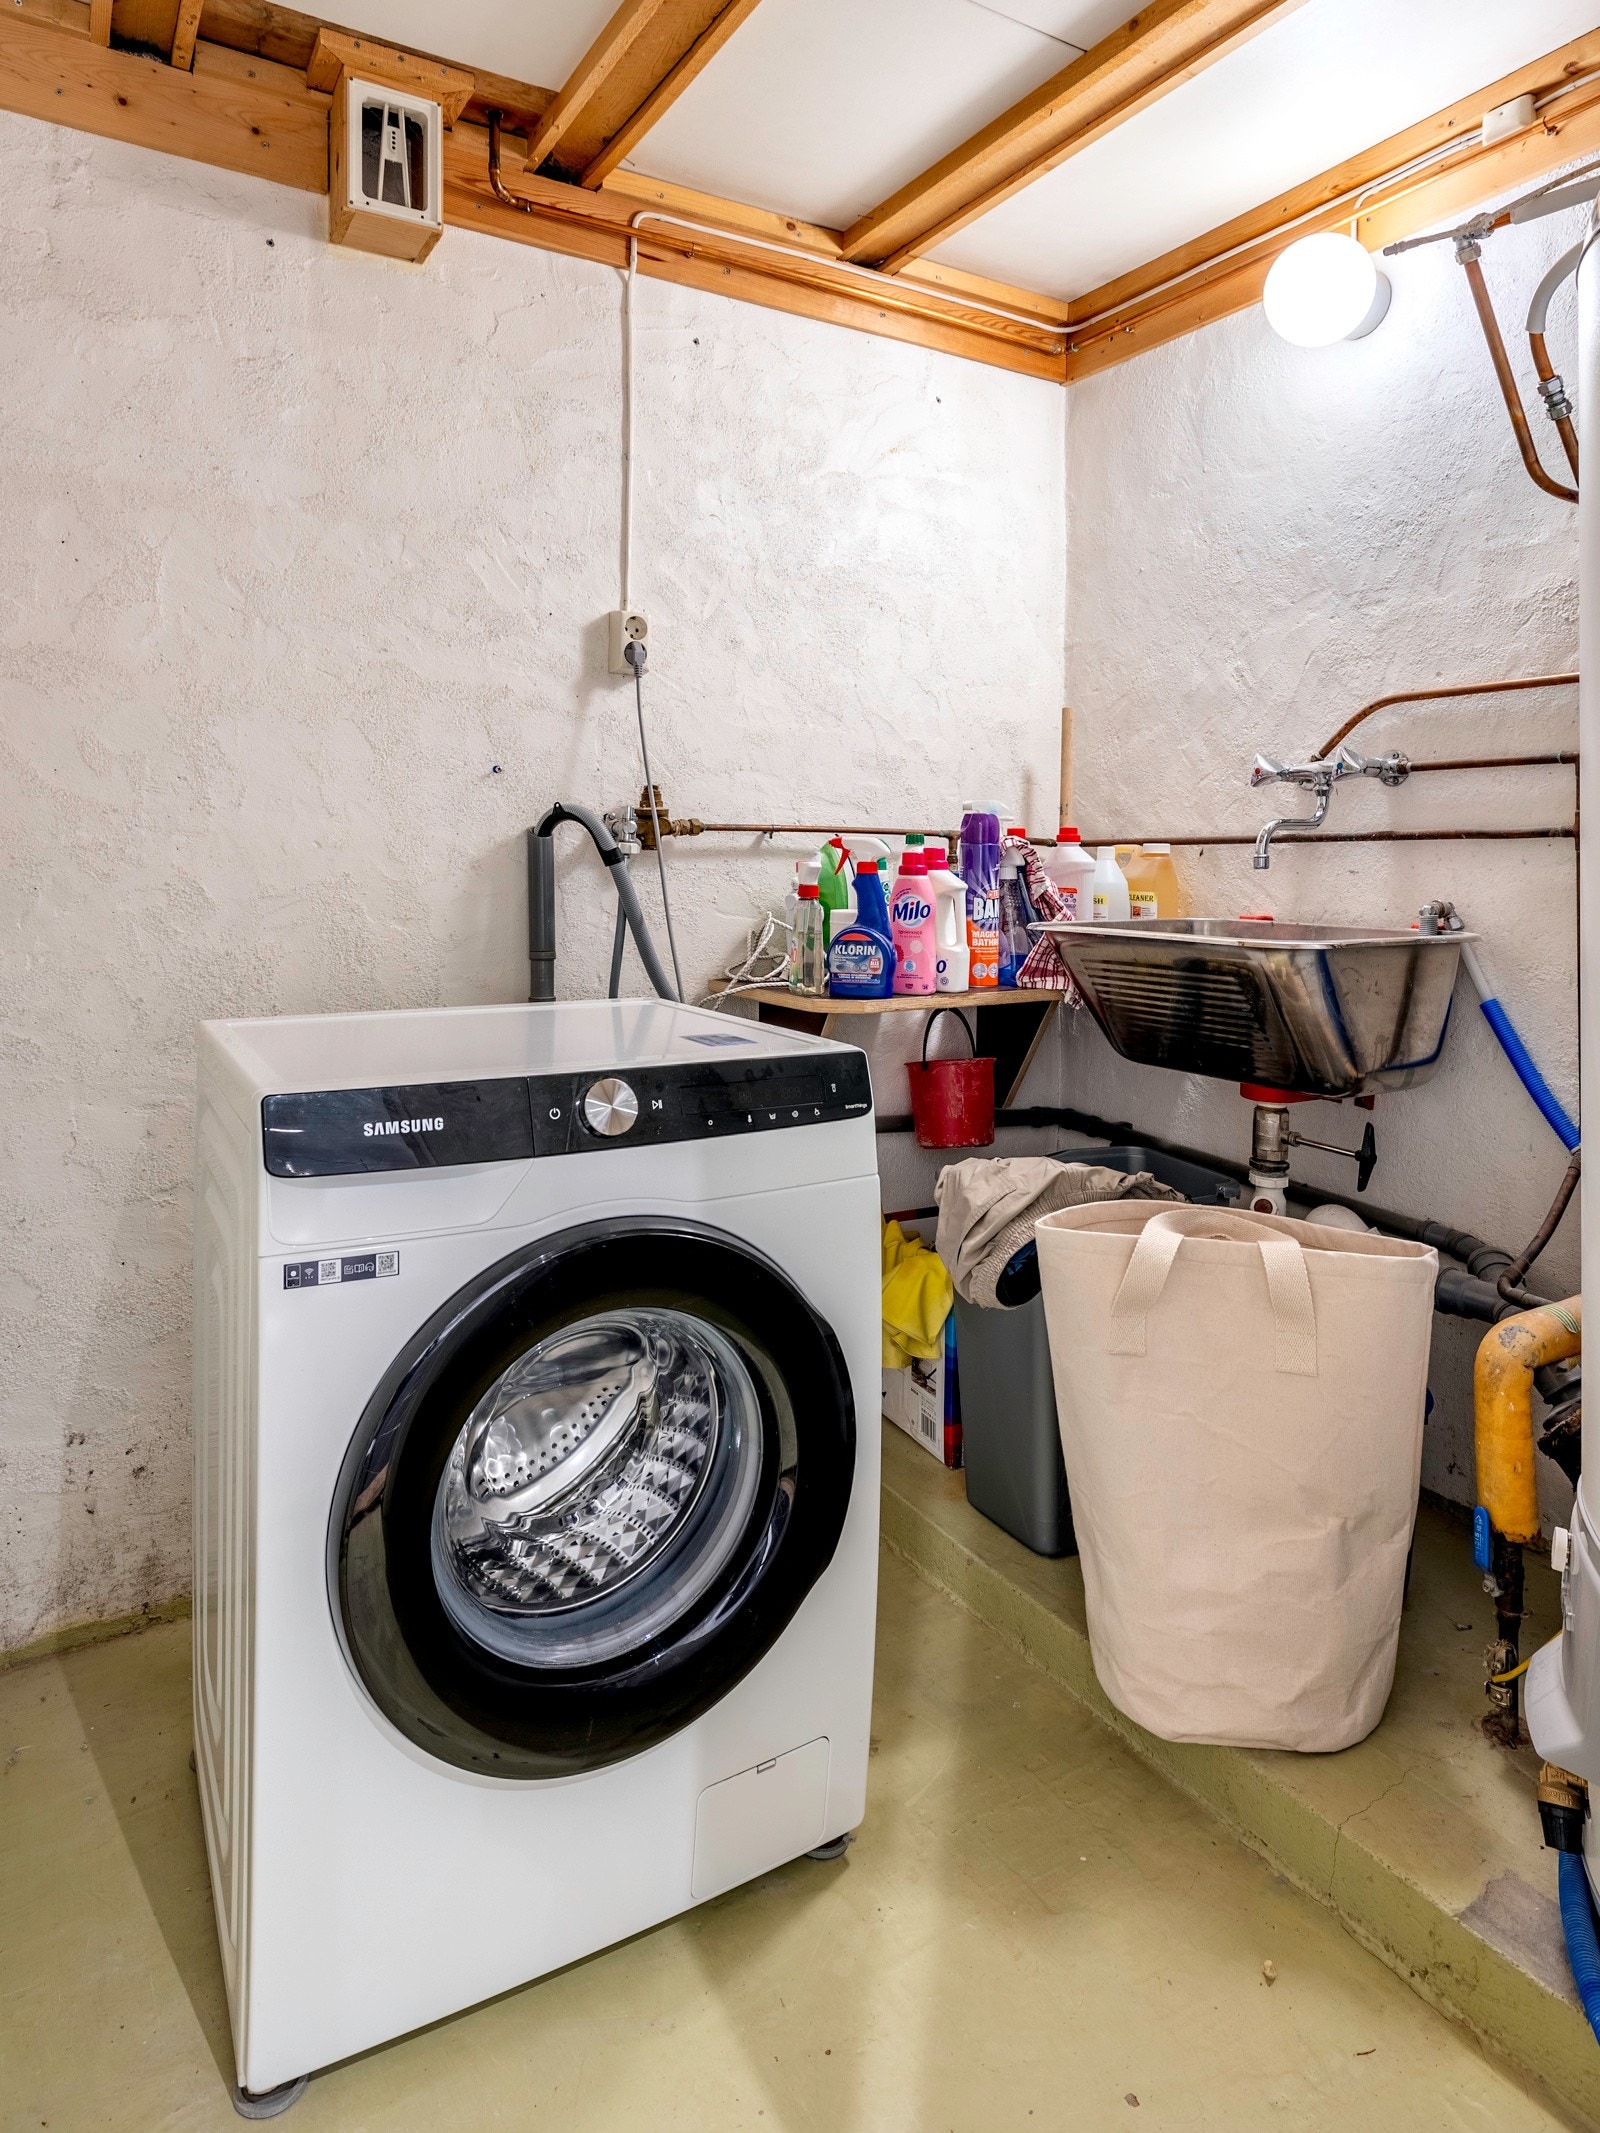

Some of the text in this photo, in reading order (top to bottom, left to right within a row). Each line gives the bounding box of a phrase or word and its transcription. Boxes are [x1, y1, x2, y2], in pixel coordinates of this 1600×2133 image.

[892, 900, 931, 922] Milo
[834, 944, 877, 956] KLORIN
[363, 1117, 444, 1137] SAMSUNG
